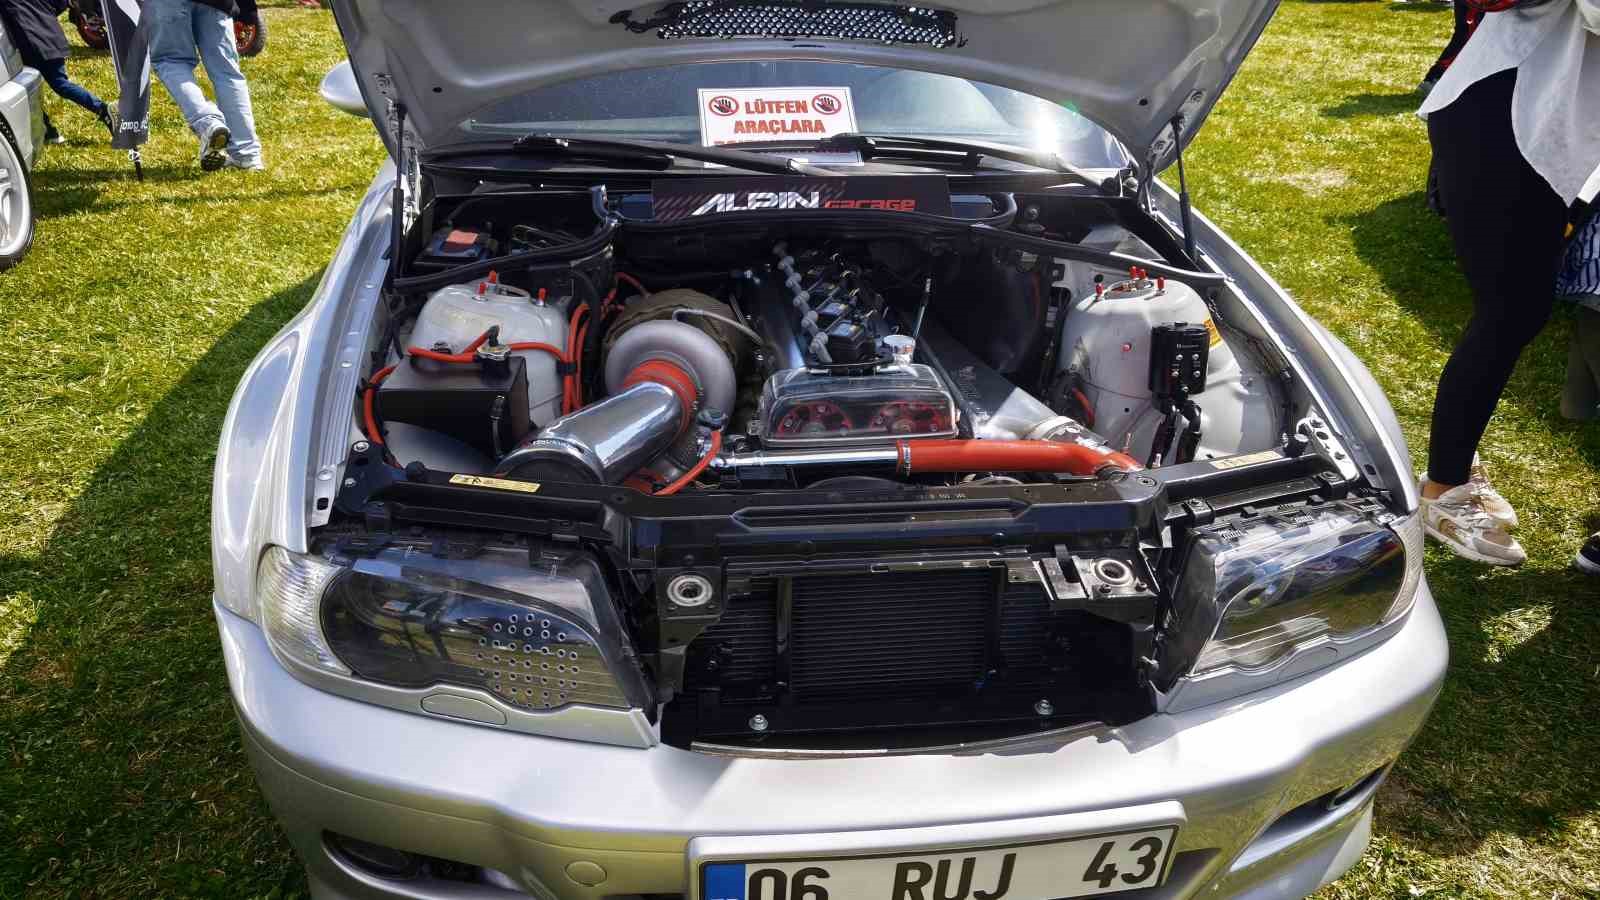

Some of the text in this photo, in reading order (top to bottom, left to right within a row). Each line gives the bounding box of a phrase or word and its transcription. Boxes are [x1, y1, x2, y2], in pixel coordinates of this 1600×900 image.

[744, 98, 808, 114] LÜTFEN
[734, 119, 826, 134] ARAÇLARA
[691, 192, 819, 215] ALPIN
[748, 837, 1163, 900] 06 RUJ 43
